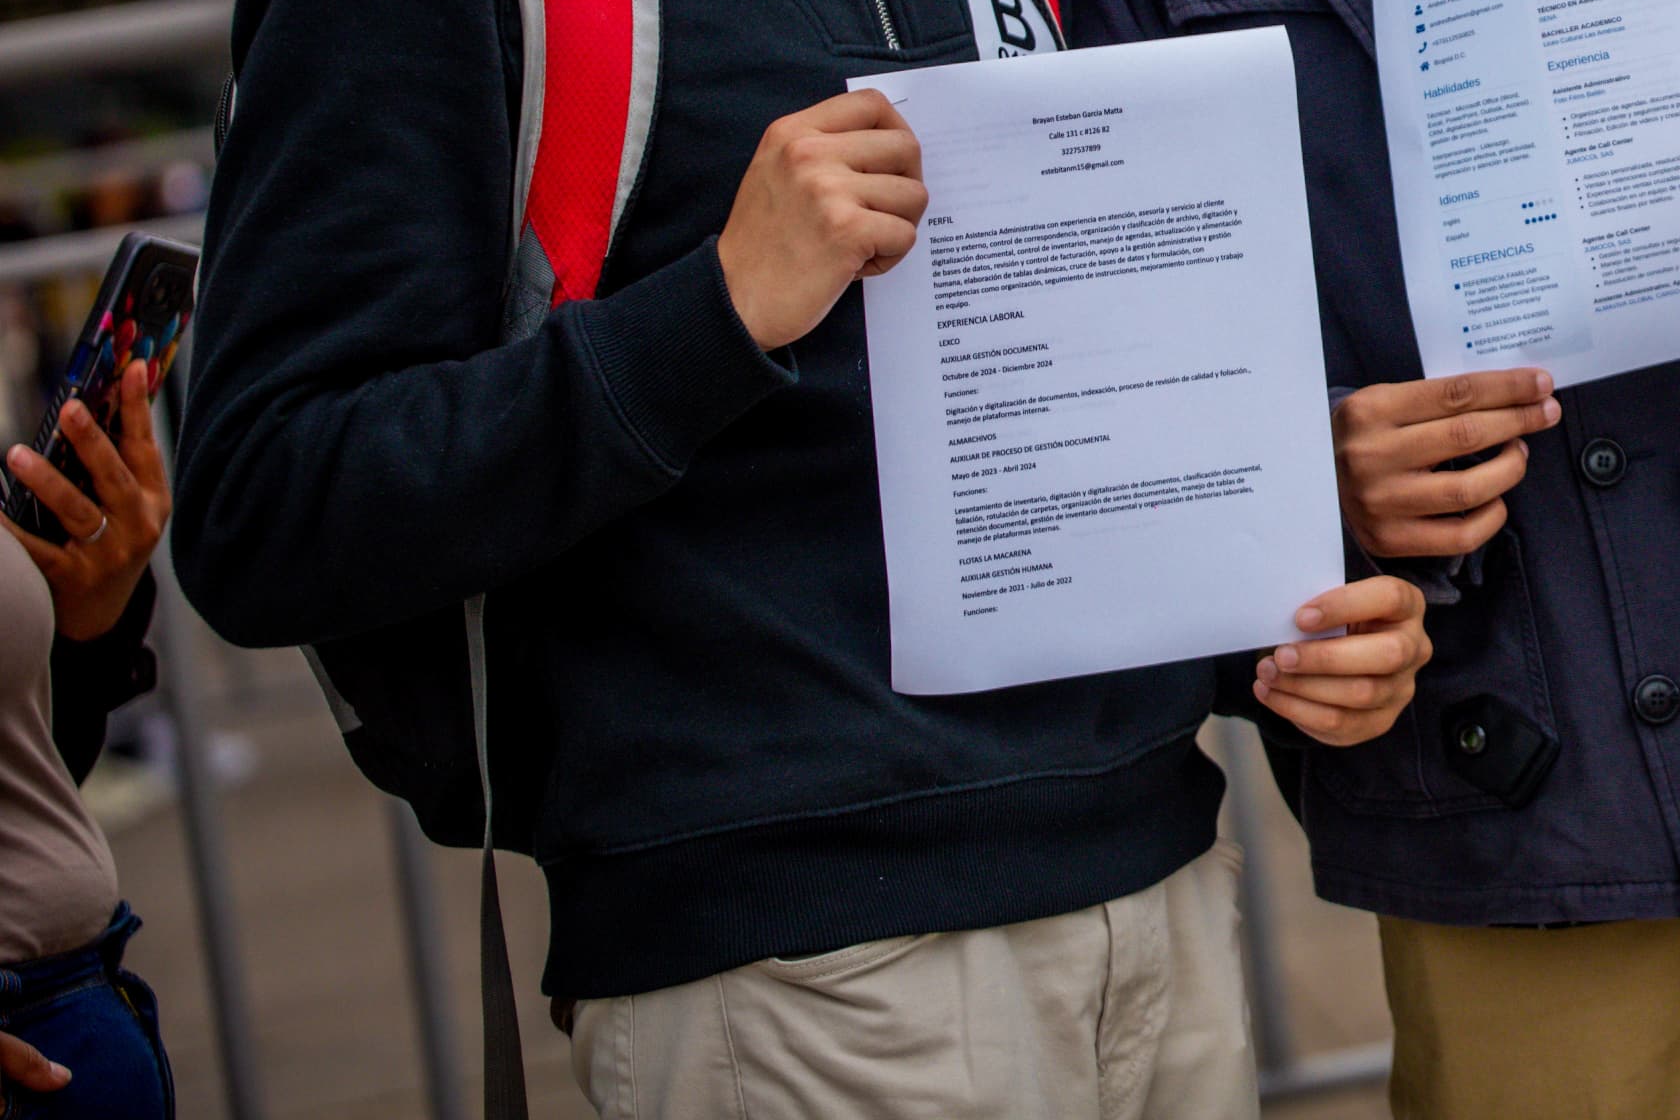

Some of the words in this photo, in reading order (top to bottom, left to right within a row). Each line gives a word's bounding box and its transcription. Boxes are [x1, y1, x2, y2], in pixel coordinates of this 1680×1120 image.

[1066, 129, 1078, 138] 131
[980, 367, 997, 376] 2024
[1036, 360, 1053, 369] 2024
[981, 451, 991, 459] DE
[1023, 445, 1033, 453] DE
[981, 467, 998, 477] 2023
[1020, 462, 1037, 471] 2024
[1009, 584, 1025, 593] 2021
[1056, 576, 1072, 585] 2022
